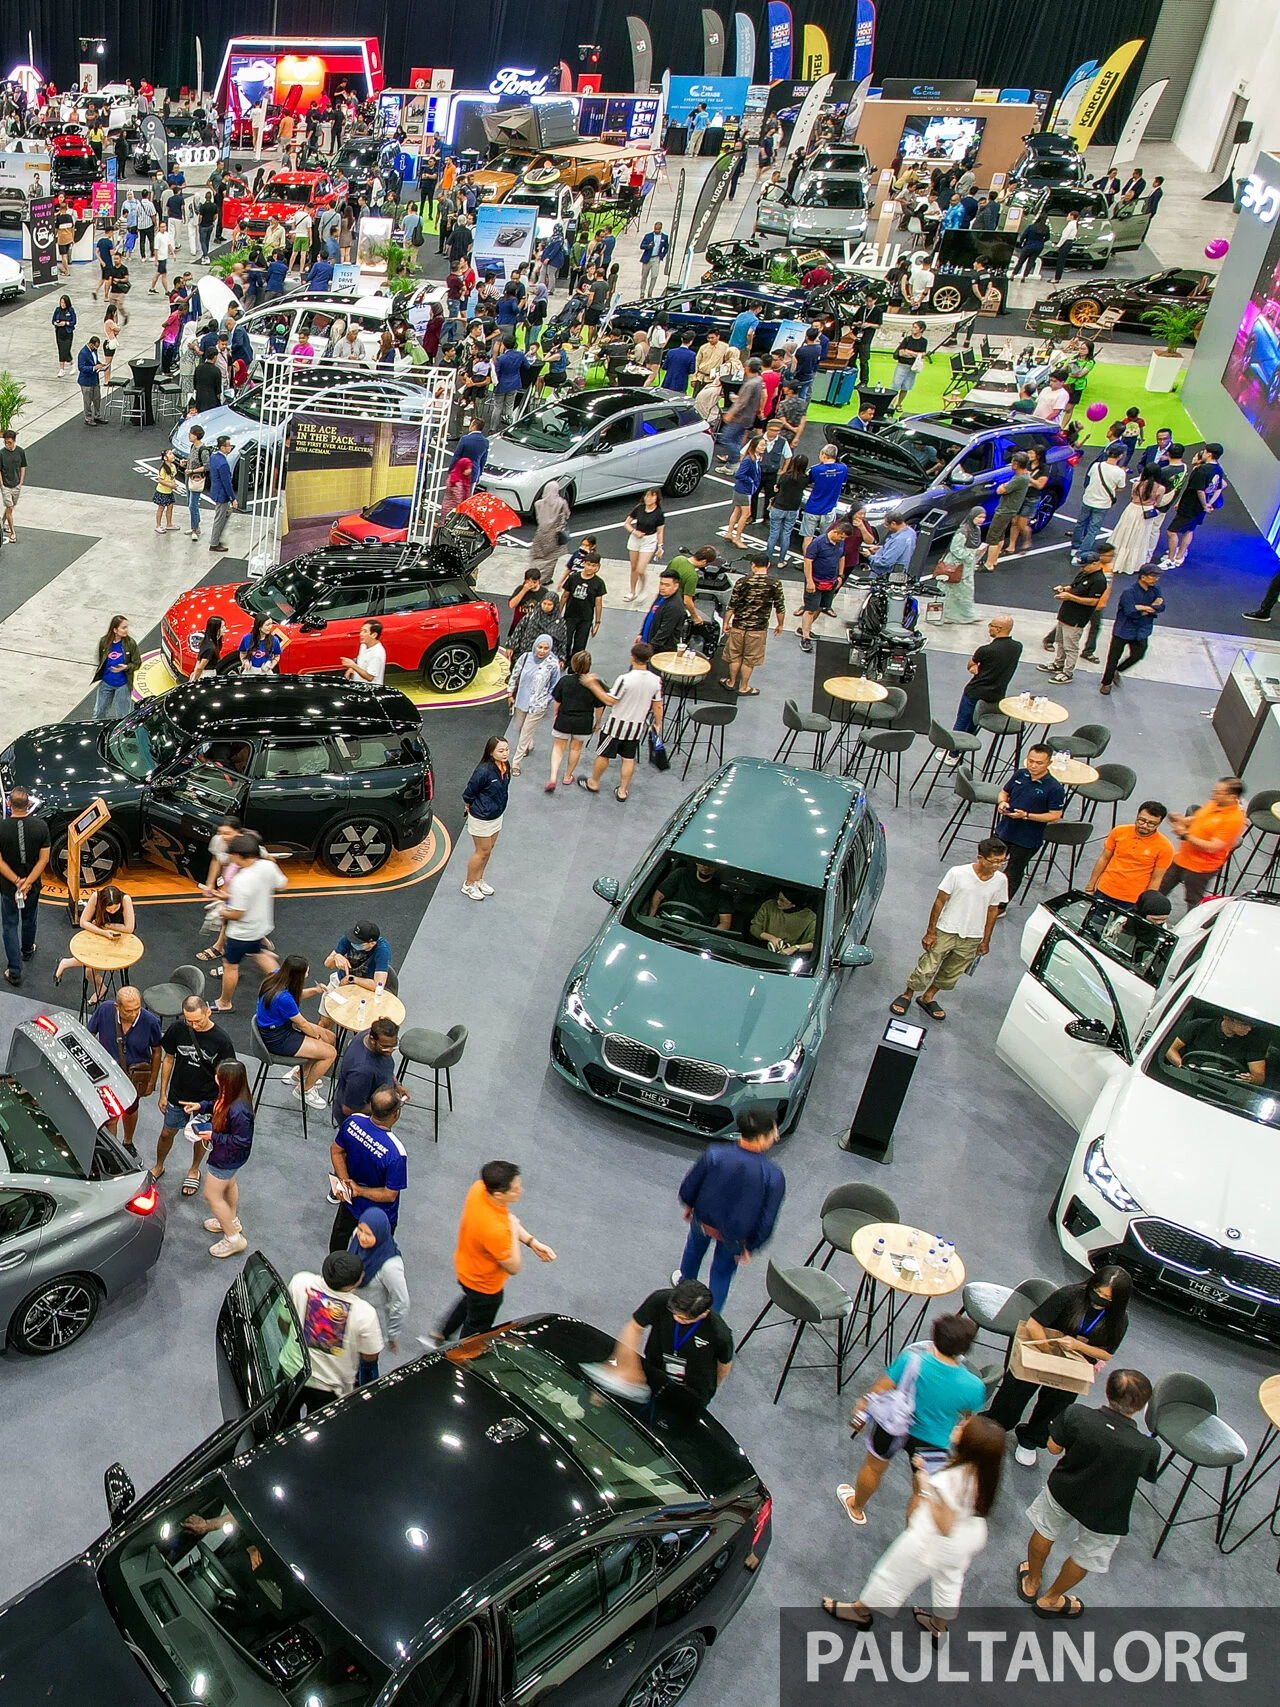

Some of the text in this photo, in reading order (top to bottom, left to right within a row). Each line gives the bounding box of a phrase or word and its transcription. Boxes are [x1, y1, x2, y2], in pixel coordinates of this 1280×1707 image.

[772, 22, 790, 32] LIQUI
[857, 21, 872, 30] LIQUI
[857, 28, 872, 37] MOLY
[772, 29, 790, 39] MOLY
[489, 67, 549, 96] Ford
[1078, 70, 1114, 127] KÄRCHER
[297, 423, 337, 435] THE ACE
[297, 432, 357, 446] IN THE PACK.
[640, 1090, 670, 1105] THE iX1
[363, 1140, 376, 1152] CITY
[374, 1149, 384, 1159] FC
[1189, 1279, 1230, 1301] THE iX2
